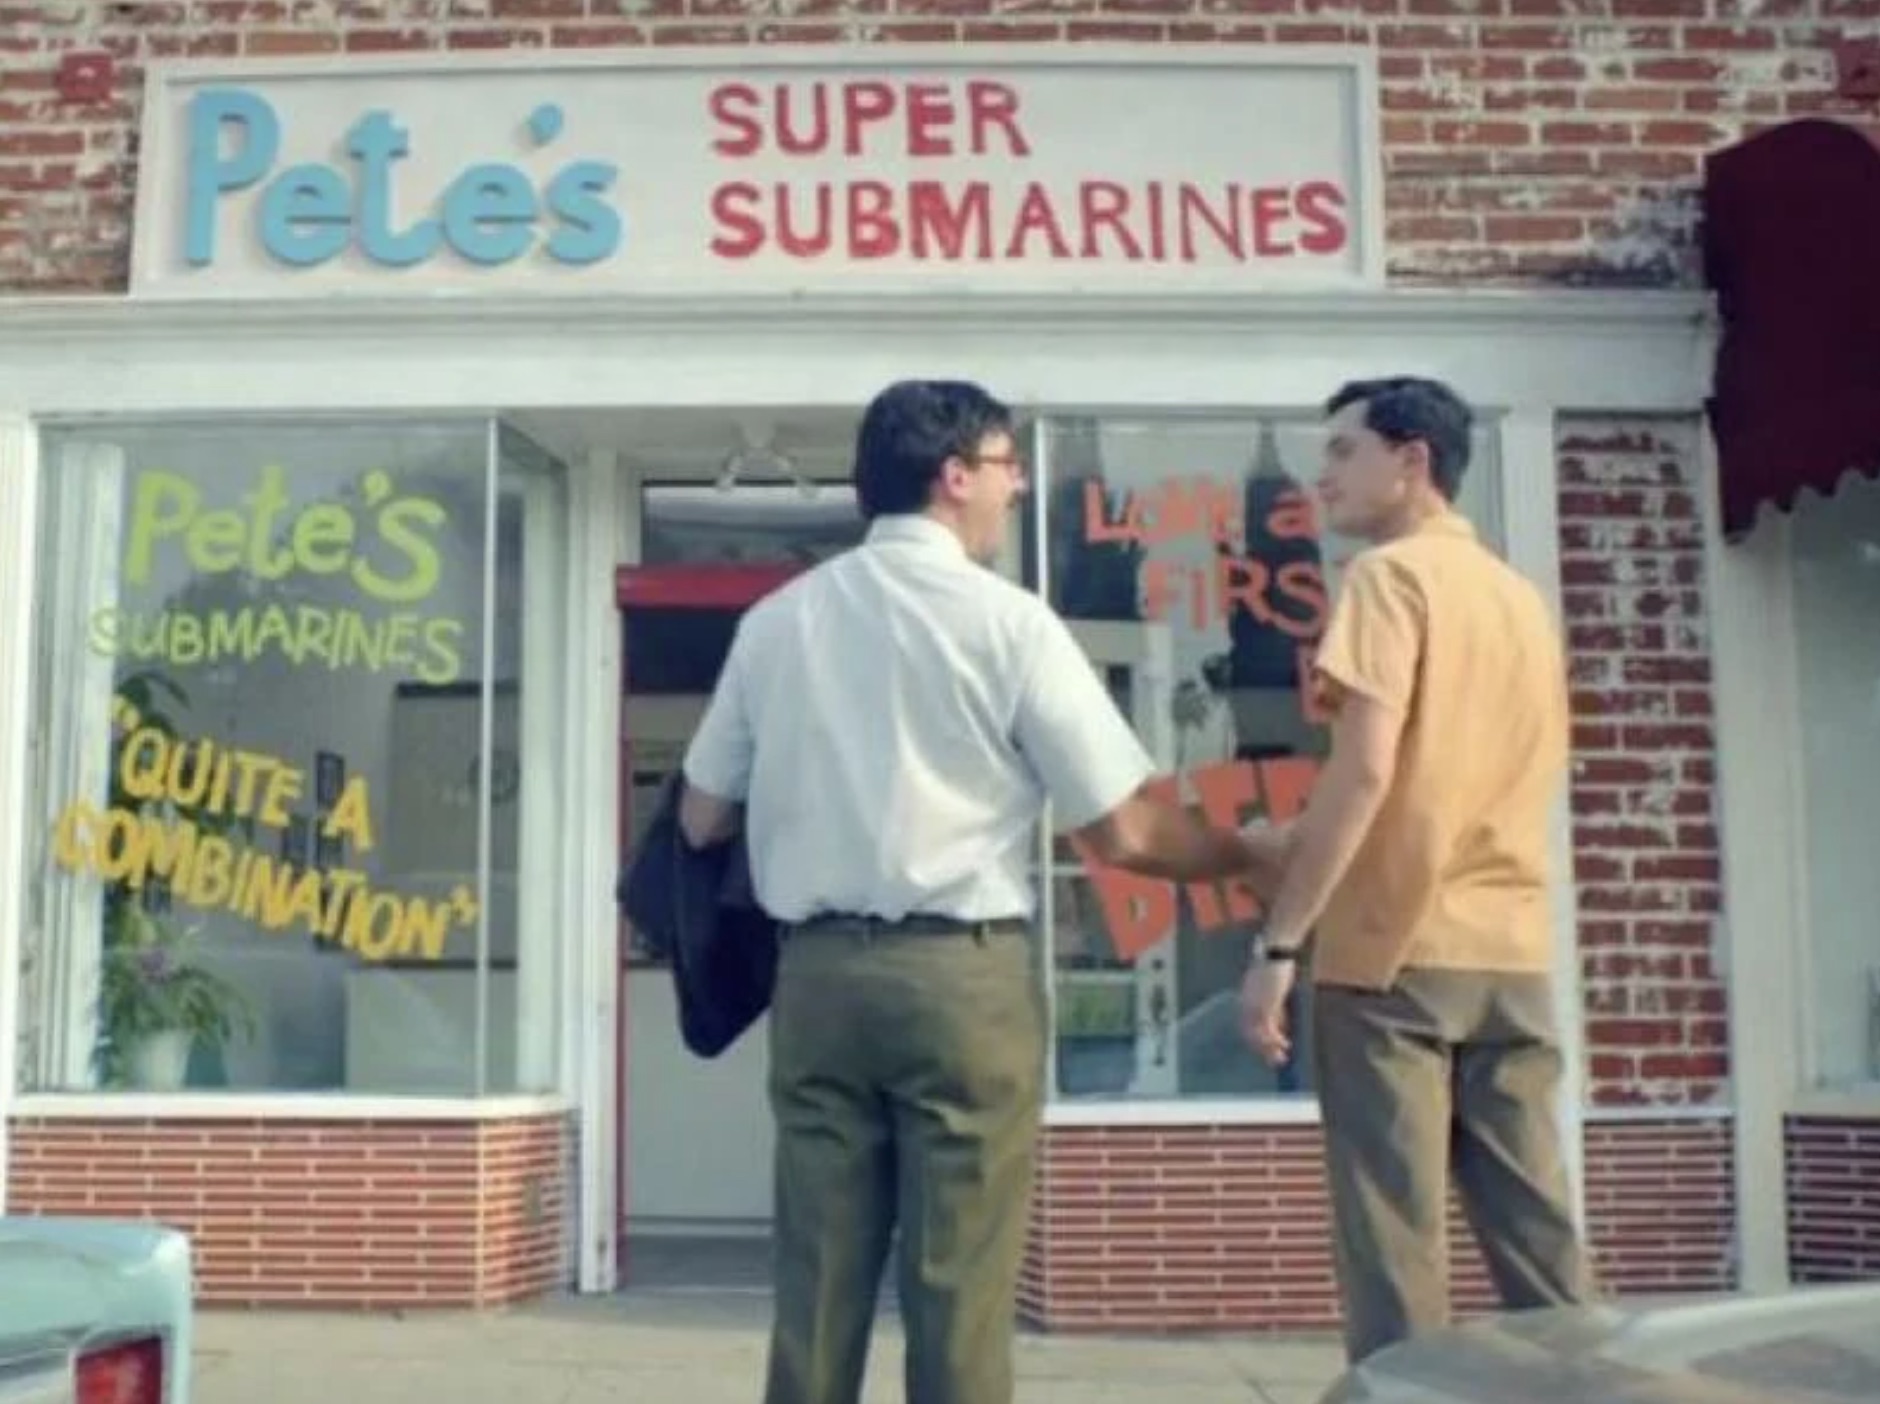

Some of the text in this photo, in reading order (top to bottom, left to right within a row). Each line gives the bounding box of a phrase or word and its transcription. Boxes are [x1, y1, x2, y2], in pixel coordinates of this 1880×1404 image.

[708, 81, 1031, 157] SUPER
[184, 84, 624, 267] Pete's
[708, 181, 1348, 261] SUBMARINES
[1146, 556, 1345, 638] FIRS
[88, 606, 463, 684] SUBMARINES
[322, 774, 374, 854] A
